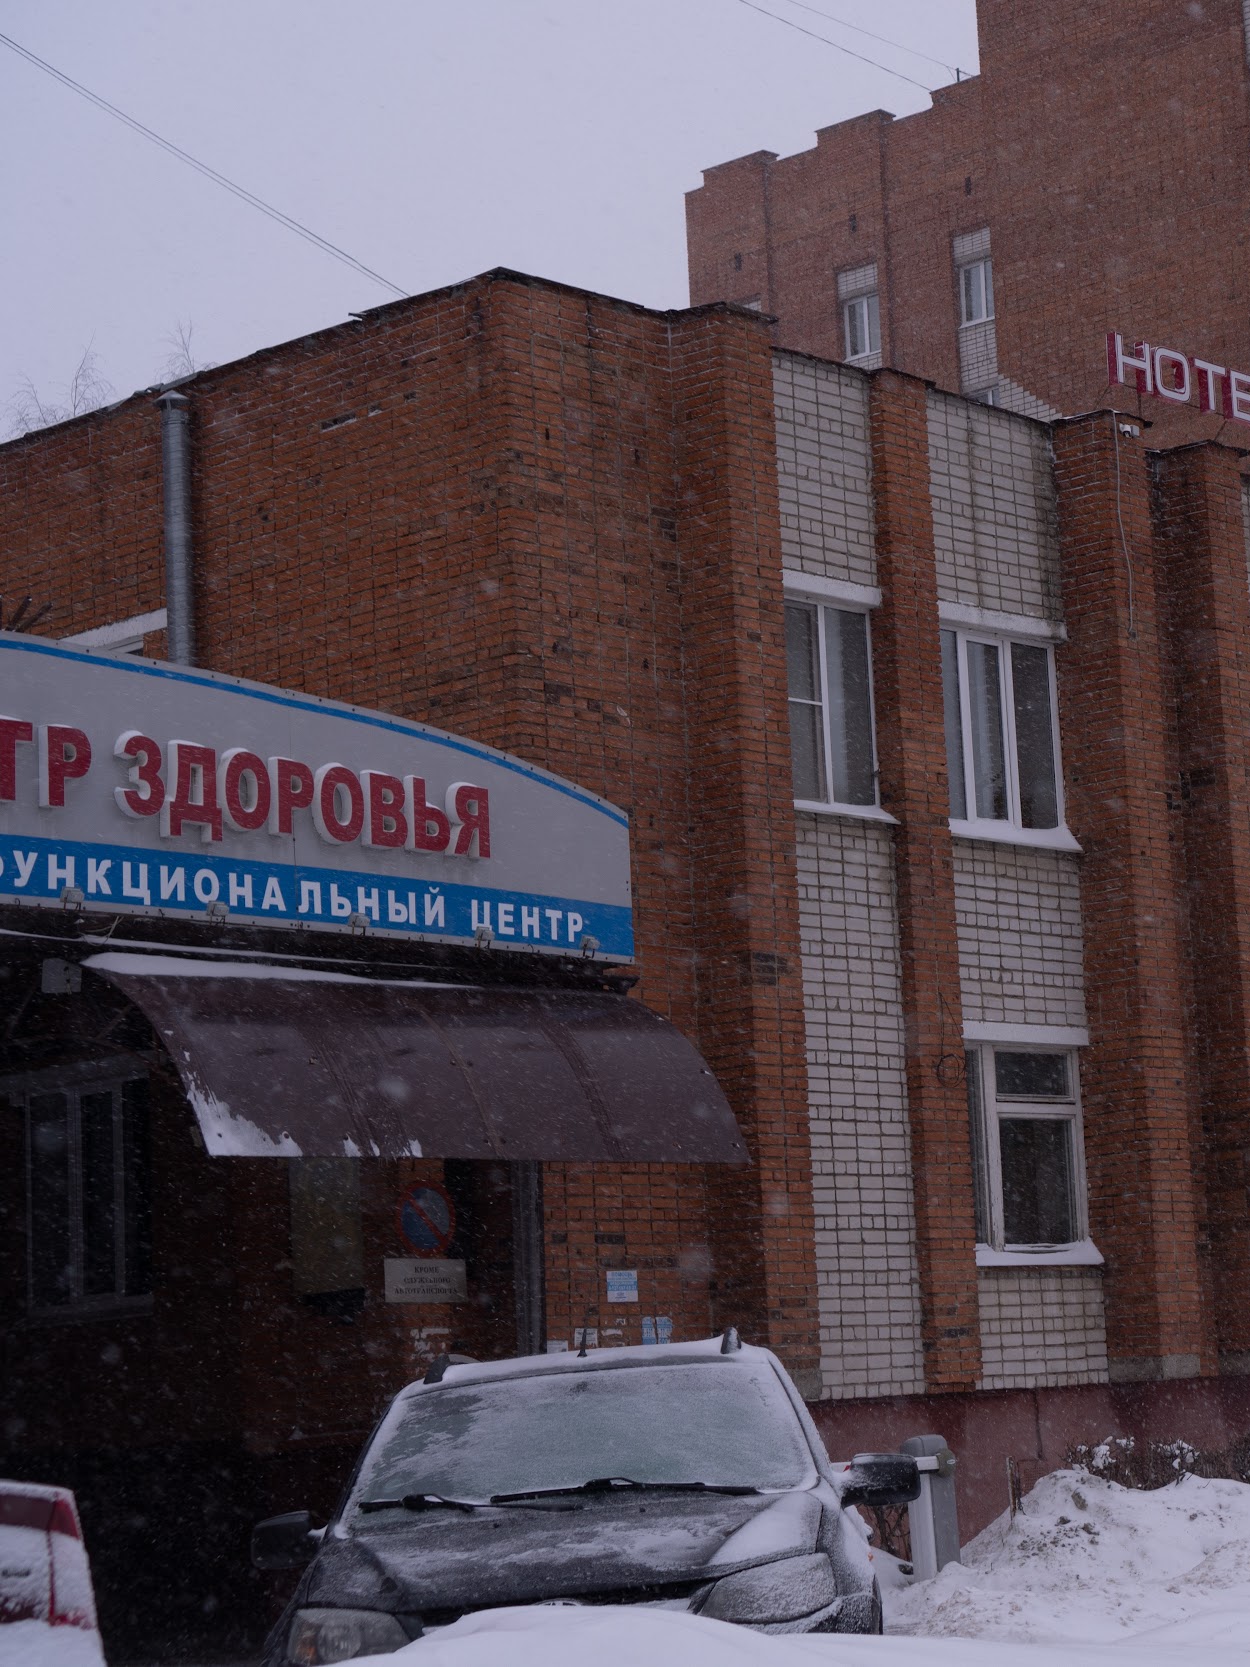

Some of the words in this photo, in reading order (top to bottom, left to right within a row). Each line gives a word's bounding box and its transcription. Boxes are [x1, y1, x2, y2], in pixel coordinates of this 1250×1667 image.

[115, 731, 491, 858] ЗДОРОВЬЯ
[0, 850, 447, 928] УНКЦИОНАЛЬНЫЙ
[471, 902, 584, 942] ЦЕНТР
[414, 1266, 440, 1274] КРОМЕ
